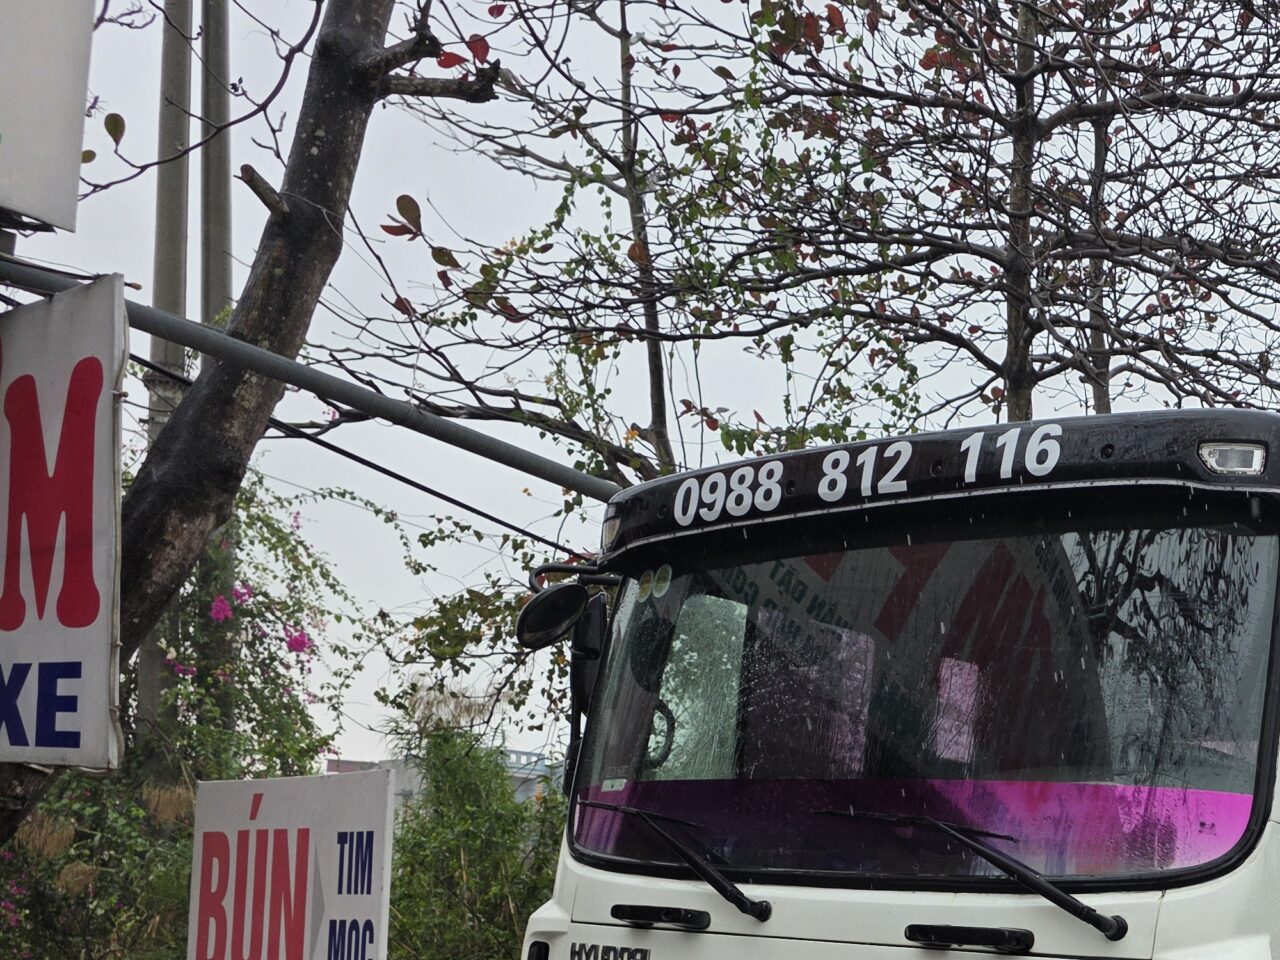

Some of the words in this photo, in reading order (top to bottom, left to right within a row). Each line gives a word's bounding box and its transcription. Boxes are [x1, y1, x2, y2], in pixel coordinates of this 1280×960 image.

[673, 460, 785, 528] 0988
[817, 440, 915, 503] 812
[958, 422, 1063, 484] 116
[0, 661, 82, 748] XE
[337, 830, 374, 896] TIM
